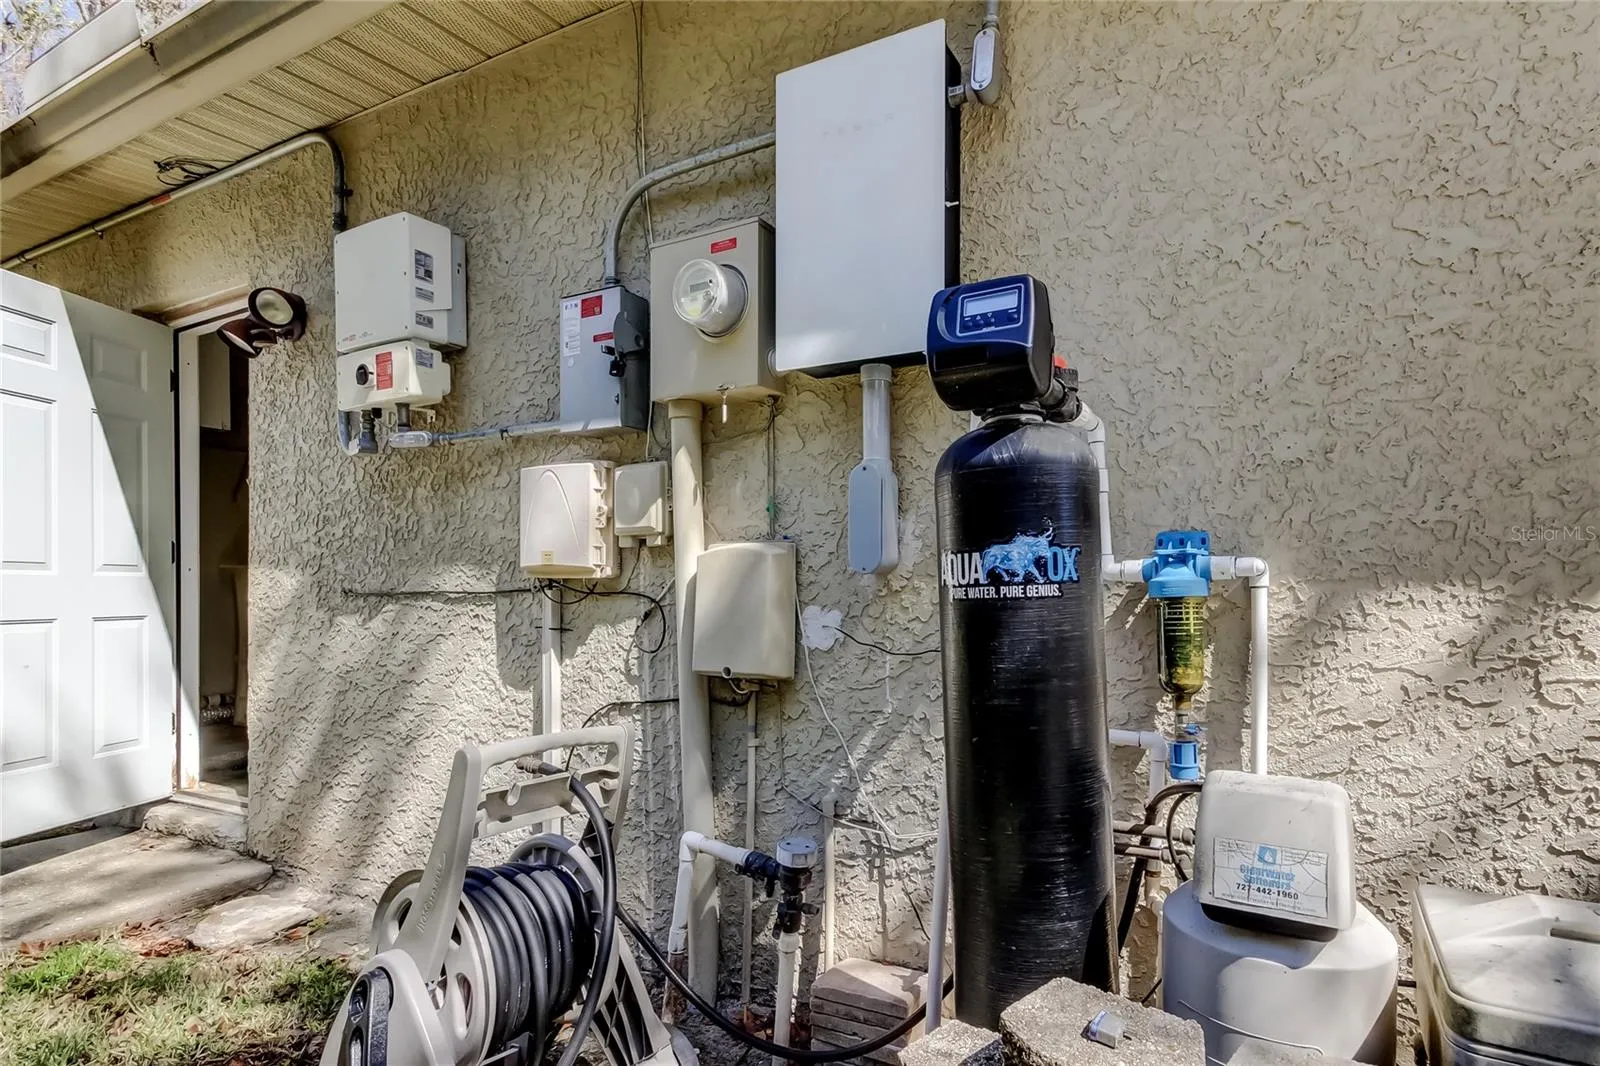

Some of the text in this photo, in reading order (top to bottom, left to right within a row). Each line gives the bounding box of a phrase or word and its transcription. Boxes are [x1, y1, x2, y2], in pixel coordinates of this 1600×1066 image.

[941, 546, 1080, 586] AQUA OX
[967, 586, 998, 599] WATER.
[1000, 585, 1024, 597] PURE
[1026, 584, 1061, 597] GENIUS.
[1236, 882, 1299, 900] 727-442-1960
